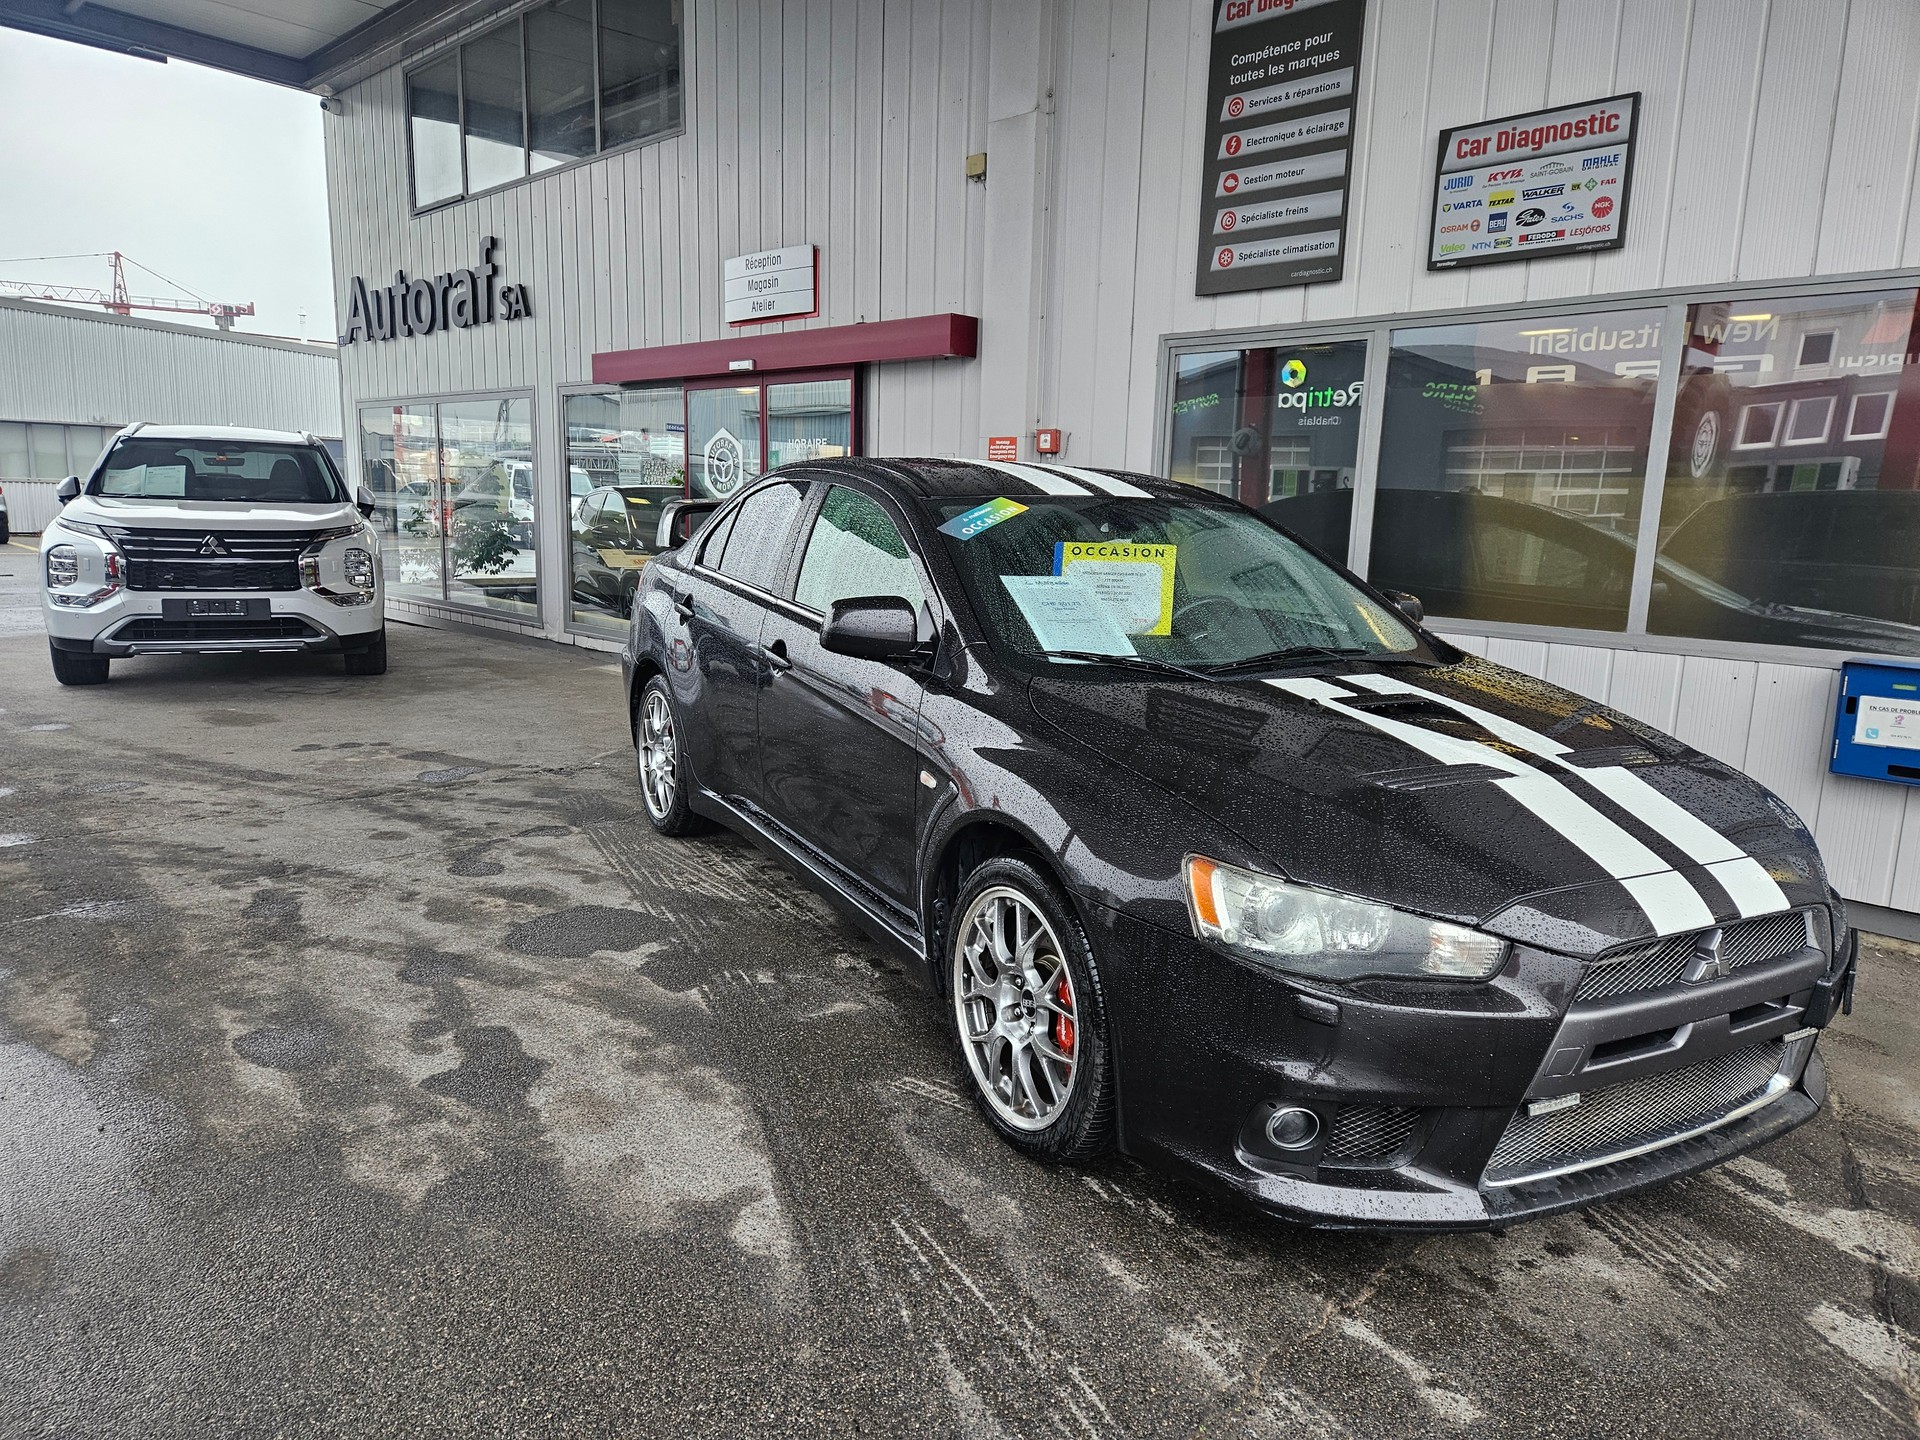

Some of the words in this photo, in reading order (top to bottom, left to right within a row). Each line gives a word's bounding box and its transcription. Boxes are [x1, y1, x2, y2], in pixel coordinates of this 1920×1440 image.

[1226, 0, 1254, 22] Car
[1231, 39, 1302, 67] Compétence
[1304, 31, 1334, 51] pour
[1229, 68, 1265, 86] toutes
[1268, 64, 1285, 76] les
[1288, 50, 1341, 72] marques
[1248, 95, 1283, 109] Services
[1284, 91, 1291, 100] &
[1292, 81, 1341, 99] réparations
[1246, 129, 1296, 147] Electronique
[1297, 128, 1304, 137] &
[1305, 121, 1345, 135] éclairage
[1456, 135, 1492, 160] Car
[1496, 110, 1620, 152] Diagnostic
[1581, 163, 1618, 172] ORIGINAL
[1582, 153, 1620, 168] MAHLE
[1243, 172, 1273, 185] Gestion
[1275, 168, 1305, 180] moteur
[1487, 168, 1524, 183] KYB
[1529, 166, 1574, 179] SAINT-GOBAIN
[1443, 175, 1475, 191] JURID
[1600, 178, 1617, 186] FAG
[1522, 186, 1565, 199] WALKER
[1453, 200, 1483, 210] VARTA
[1488, 197, 1515, 208] TEXTAR
[1594, 201, 1611, 209] NGK
[1241, 209, 1284, 224] Spécialiste
[1285, 206, 1309, 216] freins
[1551, 213, 1584, 223] SACHS
[1440, 223, 1469, 234] OSRAM
[1489, 219, 1507, 229] BERU
[1569, 224, 1612, 237] LESJÖFORS
[1495, 239, 1512, 247] SNR
[1527, 231, 1557, 241] FERODO
[1238, 246, 1281, 262] Spécialiste
[1282, 240, 1335, 255] climatisation
[1471, 241, 1492, 251] NTN
[745, 254, 782, 271] Réception
[1290, 267, 1333, 278] cardiagnostic.ch
[343, 235, 496, 346] Autoraf
[499, 283, 532, 321] SA
[747, 275, 779, 293] Magasin
[751, 299, 776, 313] Atelier
[788, 437, 828, 450] HORAIRE
[716, 475, 737, 491] MORET
[962, 505, 1019, 534] OCCASION
[1071, 546, 1165, 558] OCCASION
